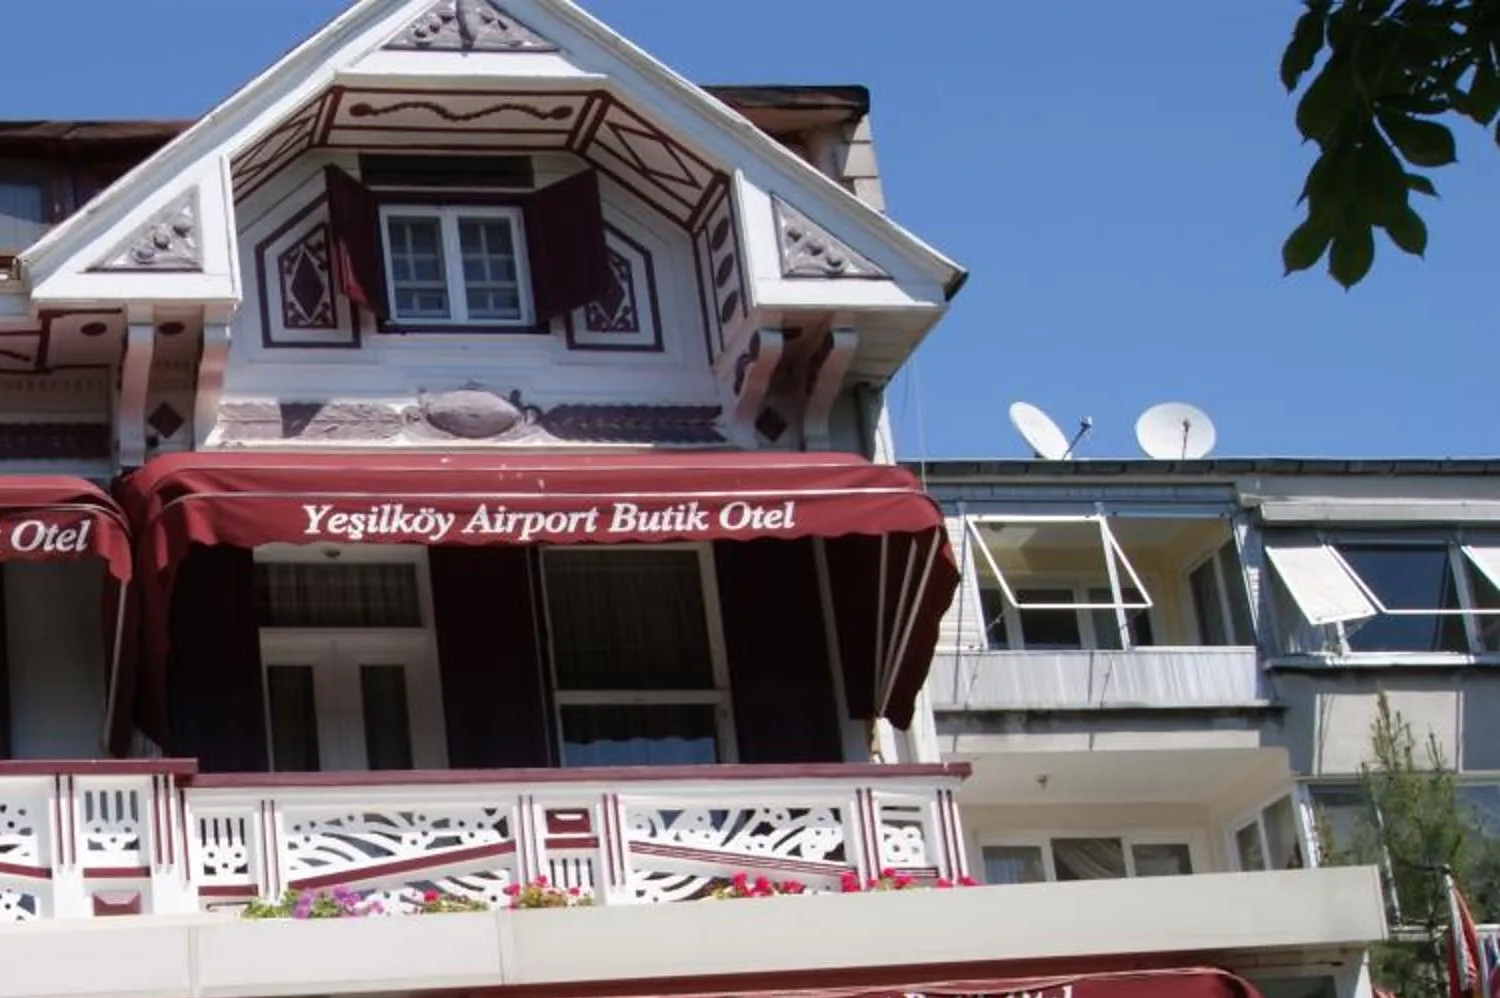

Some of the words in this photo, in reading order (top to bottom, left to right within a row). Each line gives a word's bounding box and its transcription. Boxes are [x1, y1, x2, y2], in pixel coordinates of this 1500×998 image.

[12, 520, 90, 552] Otel
[303, 504, 456, 541] Yeşilköy
[462, 503, 598, 541] Airport
[608, 502, 709, 533] Butik
[719, 501, 795, 531] Otel
